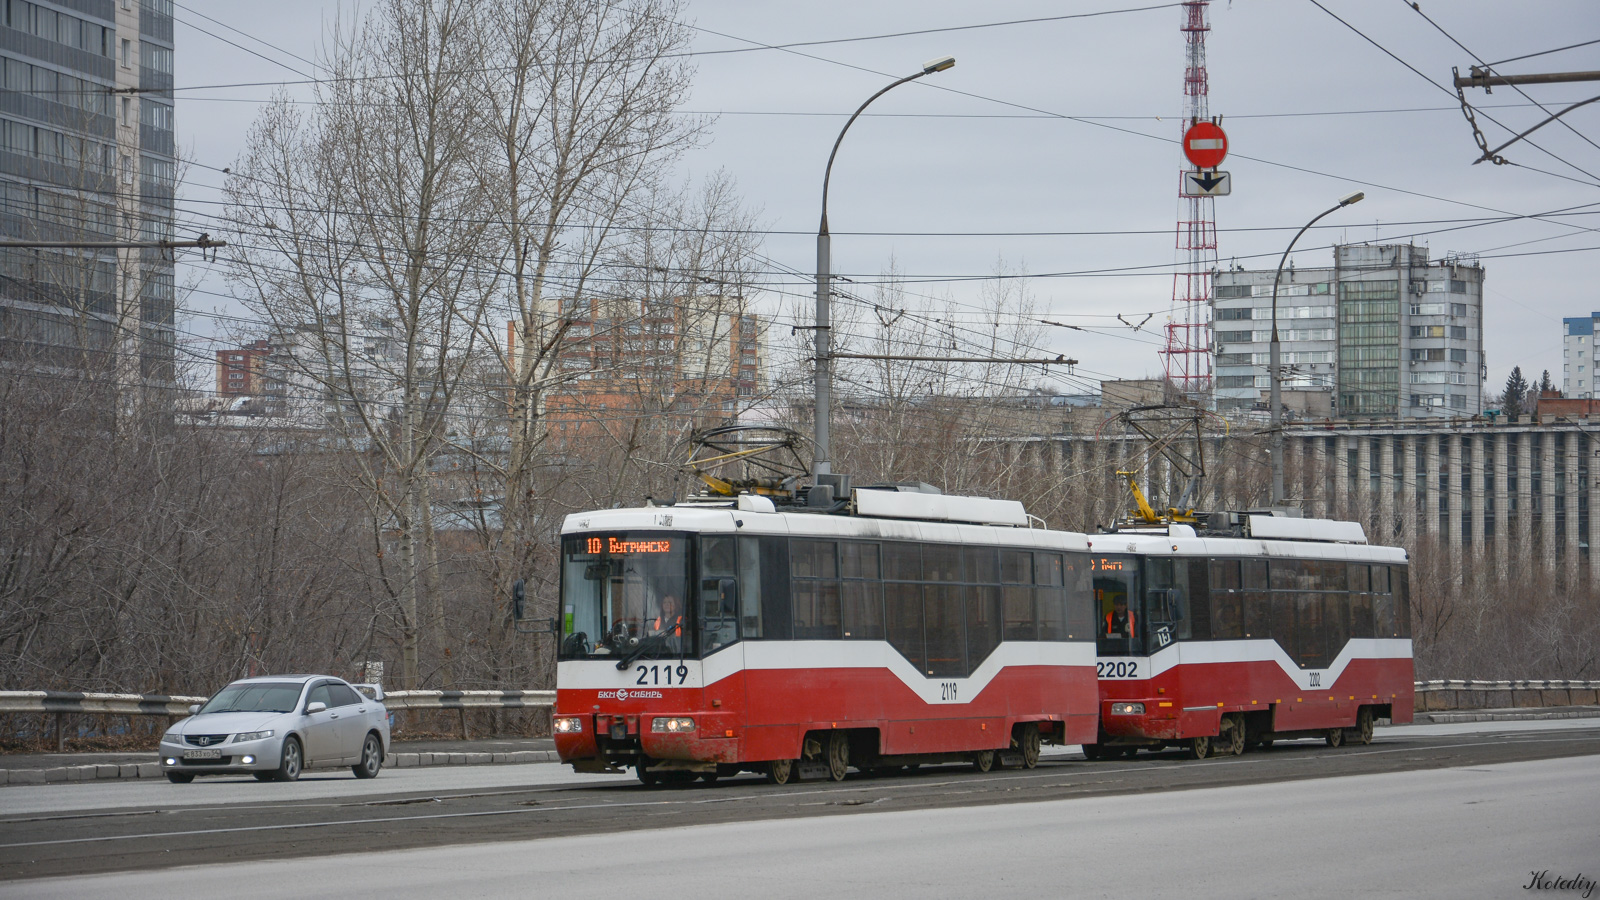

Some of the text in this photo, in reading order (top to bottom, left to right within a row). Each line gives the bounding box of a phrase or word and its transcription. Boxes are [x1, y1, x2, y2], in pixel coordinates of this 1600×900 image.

[587, 537, 602, 554] 10
[636, 665, 689, 685] 2119
[1096, 661, 1138, 678] 2202
[1309, 672, 1321, 687] 2202
[597, 690, 663, 699] БКМ СИБИРЬ
[940, 682, 958, 701] 2119
